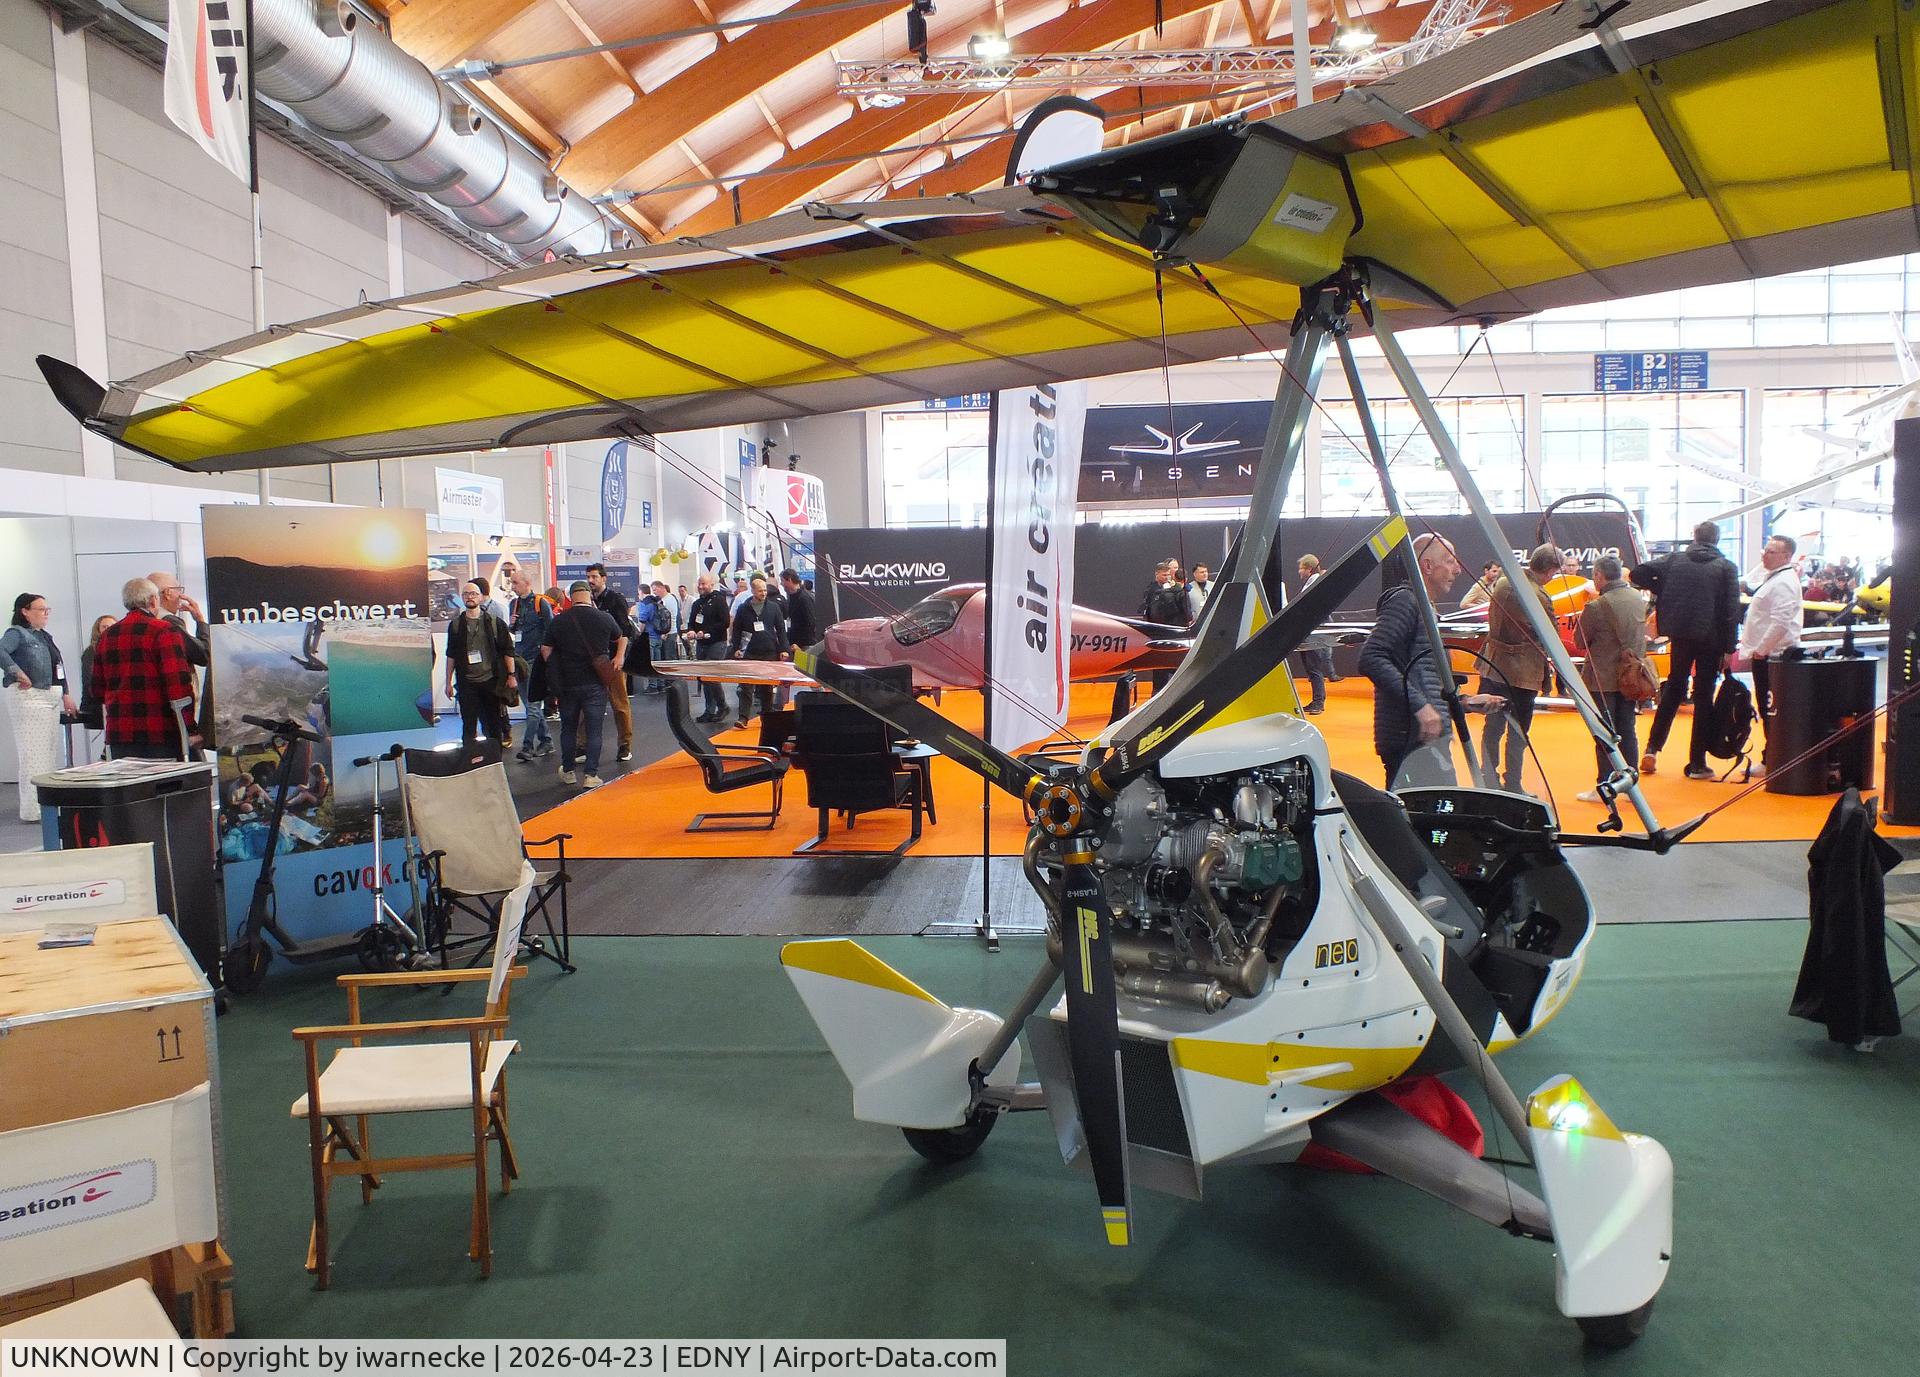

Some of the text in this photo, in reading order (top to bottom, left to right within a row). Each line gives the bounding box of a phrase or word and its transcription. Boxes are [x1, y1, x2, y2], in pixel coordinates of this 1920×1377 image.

[1642, 354, 1667, 369] B2
[1101, 463, 1252, 483] RISEN
[839, 562, 946, 578] BLACKWING
[221, 600, 418, 625] unbeschwert
[1017, 569, 1048, 653] air
[16, 890, 87, 904] air creation
[1316, 939, 1358, 968] neo
